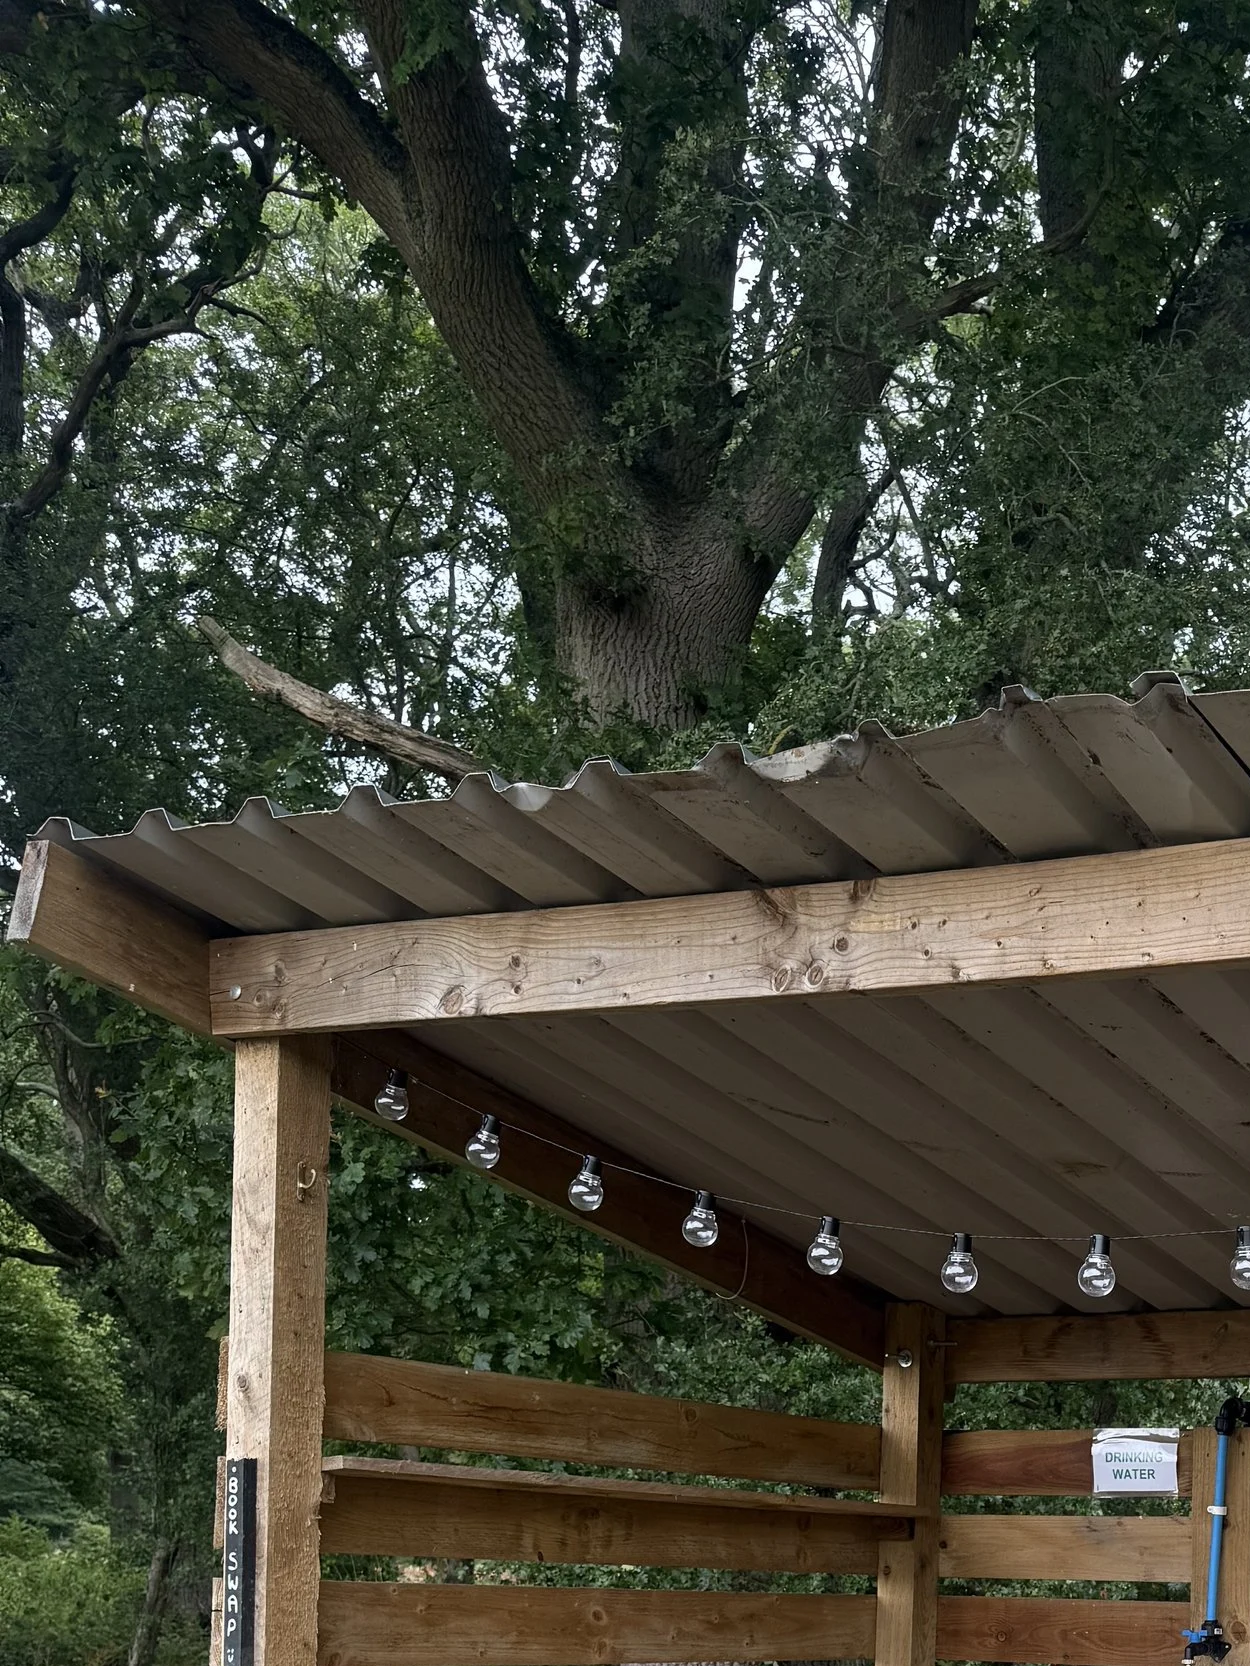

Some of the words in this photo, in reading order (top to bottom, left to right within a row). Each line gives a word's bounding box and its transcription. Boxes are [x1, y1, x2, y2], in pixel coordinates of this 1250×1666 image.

[1105, 1451, 1163, 1463] DRINKING
[1112, 1468, 1156, 1480] WATER
[228, 1476, 239, 1535] BOOK
[226, 1551, 239, 1637] SWAP
